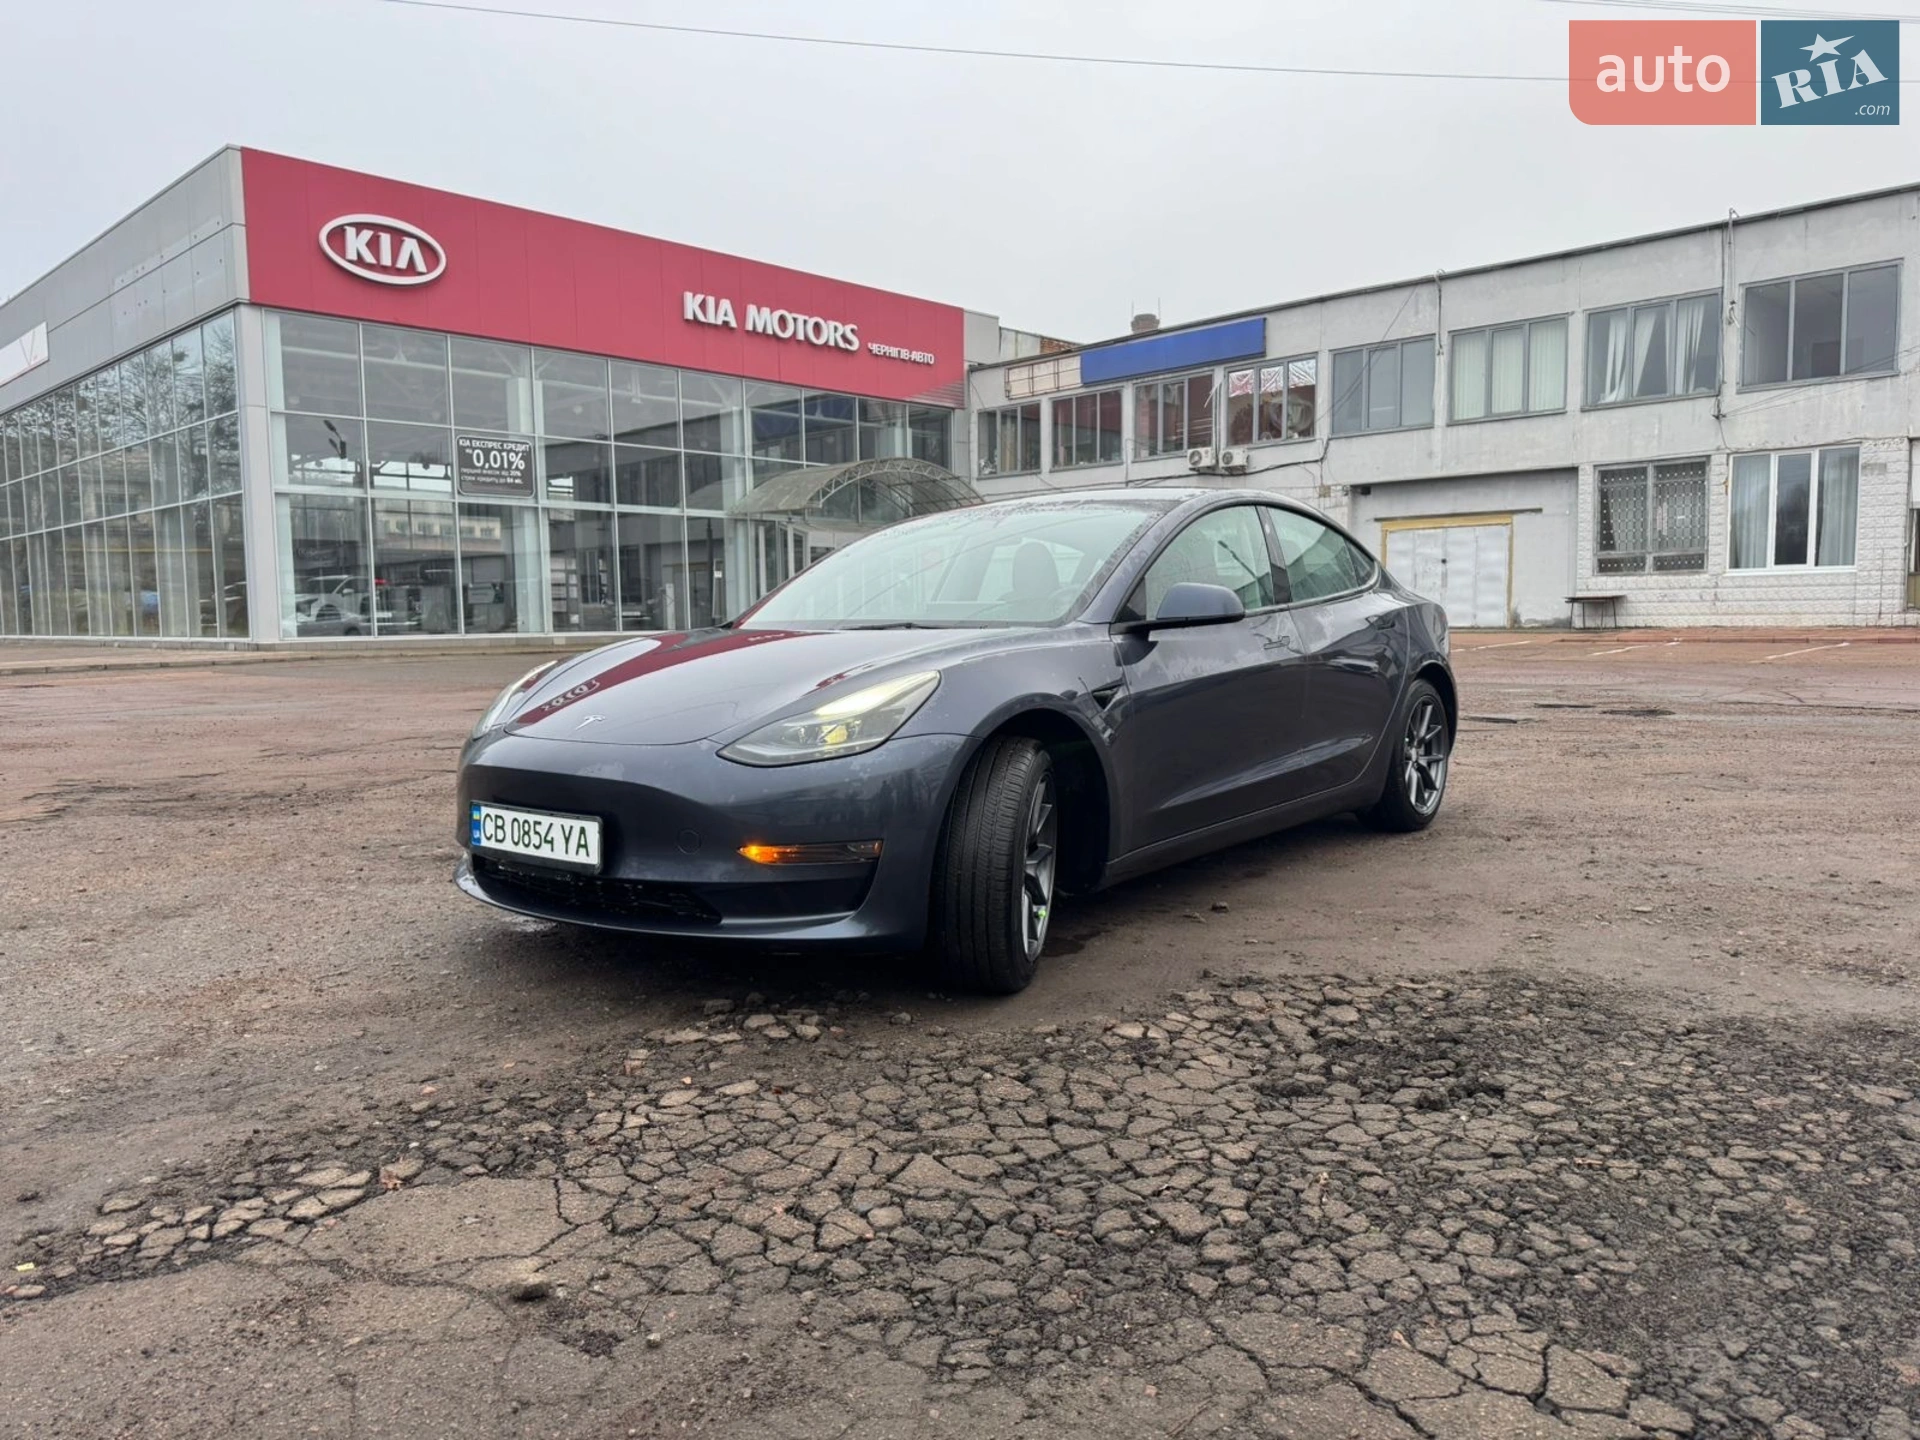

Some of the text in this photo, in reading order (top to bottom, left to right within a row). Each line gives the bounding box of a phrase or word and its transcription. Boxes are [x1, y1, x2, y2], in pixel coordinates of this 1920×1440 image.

[343, 225, 428, 274] KIA
[683, 291, 860, 351] KIA MOTORS
[473, 449, 525, 470] 0,01%
[482, 813, 590, 858] CB 0854 YA
